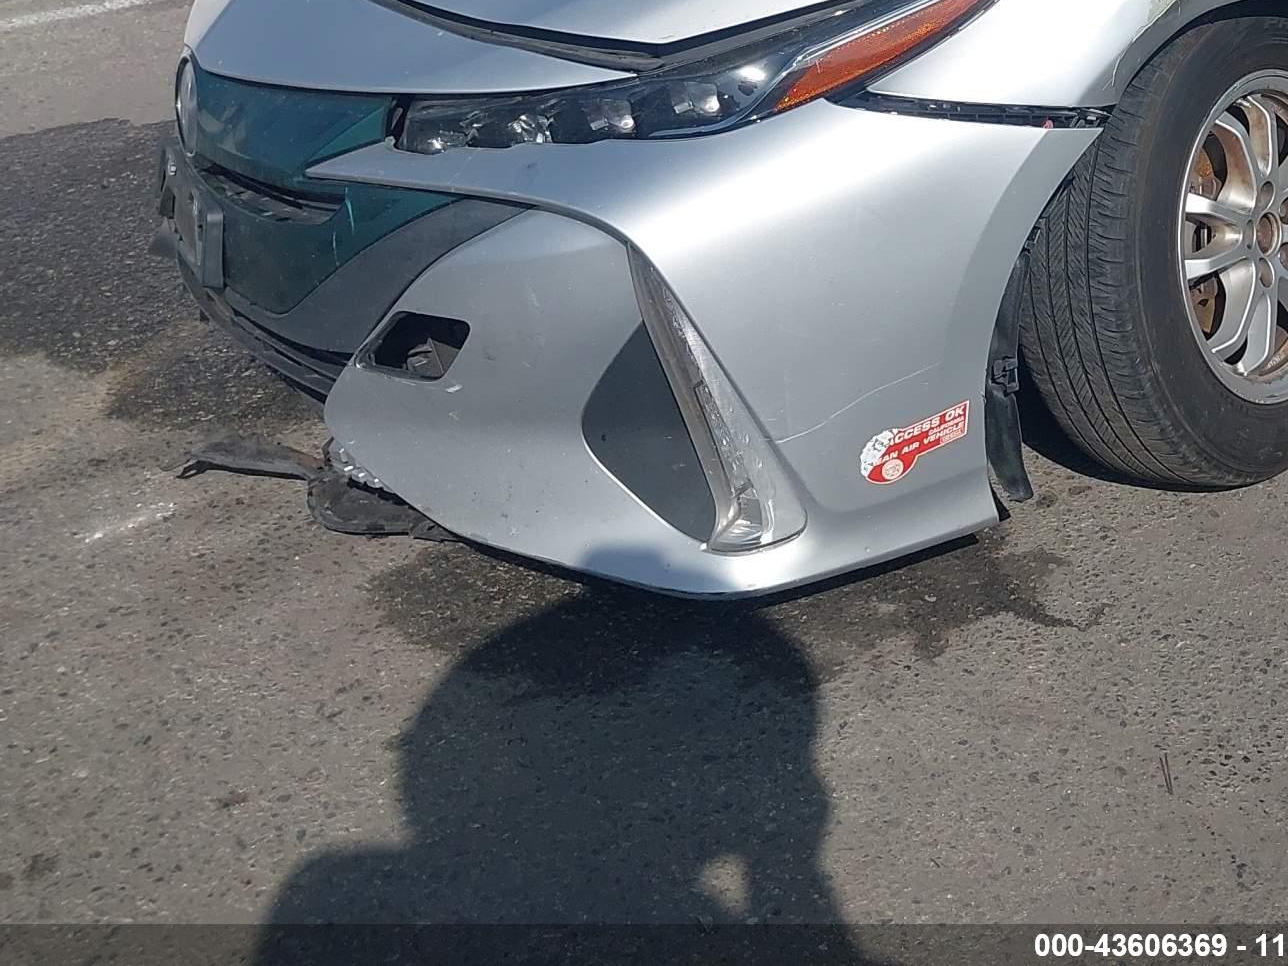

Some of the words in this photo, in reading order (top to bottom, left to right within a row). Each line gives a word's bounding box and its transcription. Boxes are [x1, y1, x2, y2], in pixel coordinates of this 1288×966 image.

[945, 405, 966, 422] OK
[901, 442, 921, 455] AIR
[923, 421, 965, 445] VEHICLE
